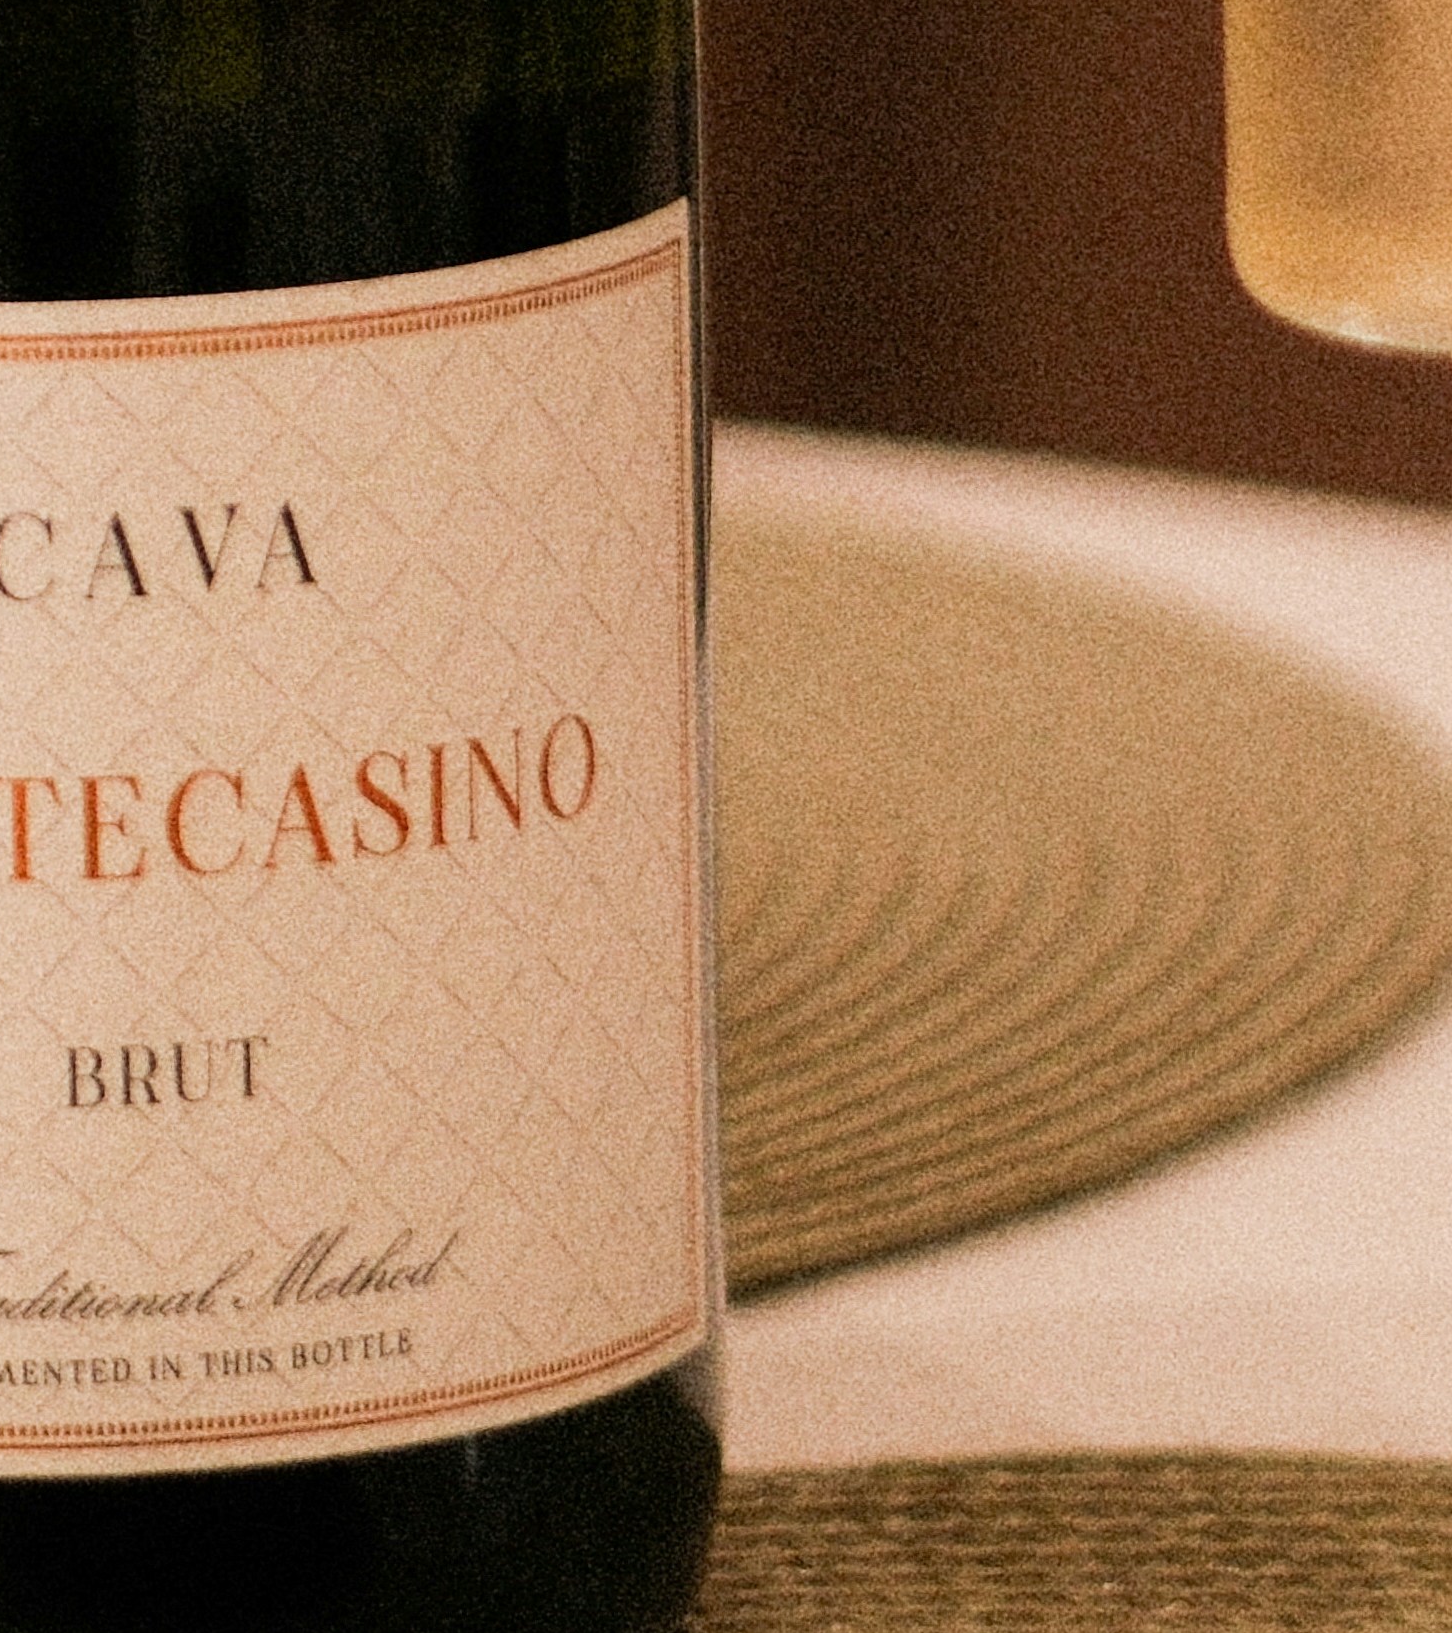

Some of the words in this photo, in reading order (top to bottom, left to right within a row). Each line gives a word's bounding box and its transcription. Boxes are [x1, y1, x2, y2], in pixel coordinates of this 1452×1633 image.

[67, 1034, 270, 1108] BRUT
[232, 1226, 459, 1311] Method
[148, 1354, 183, 1381] IN
[198, 1348, 274, 1377] THIS
[289, 1326, 414, 1372] BOTTLE
